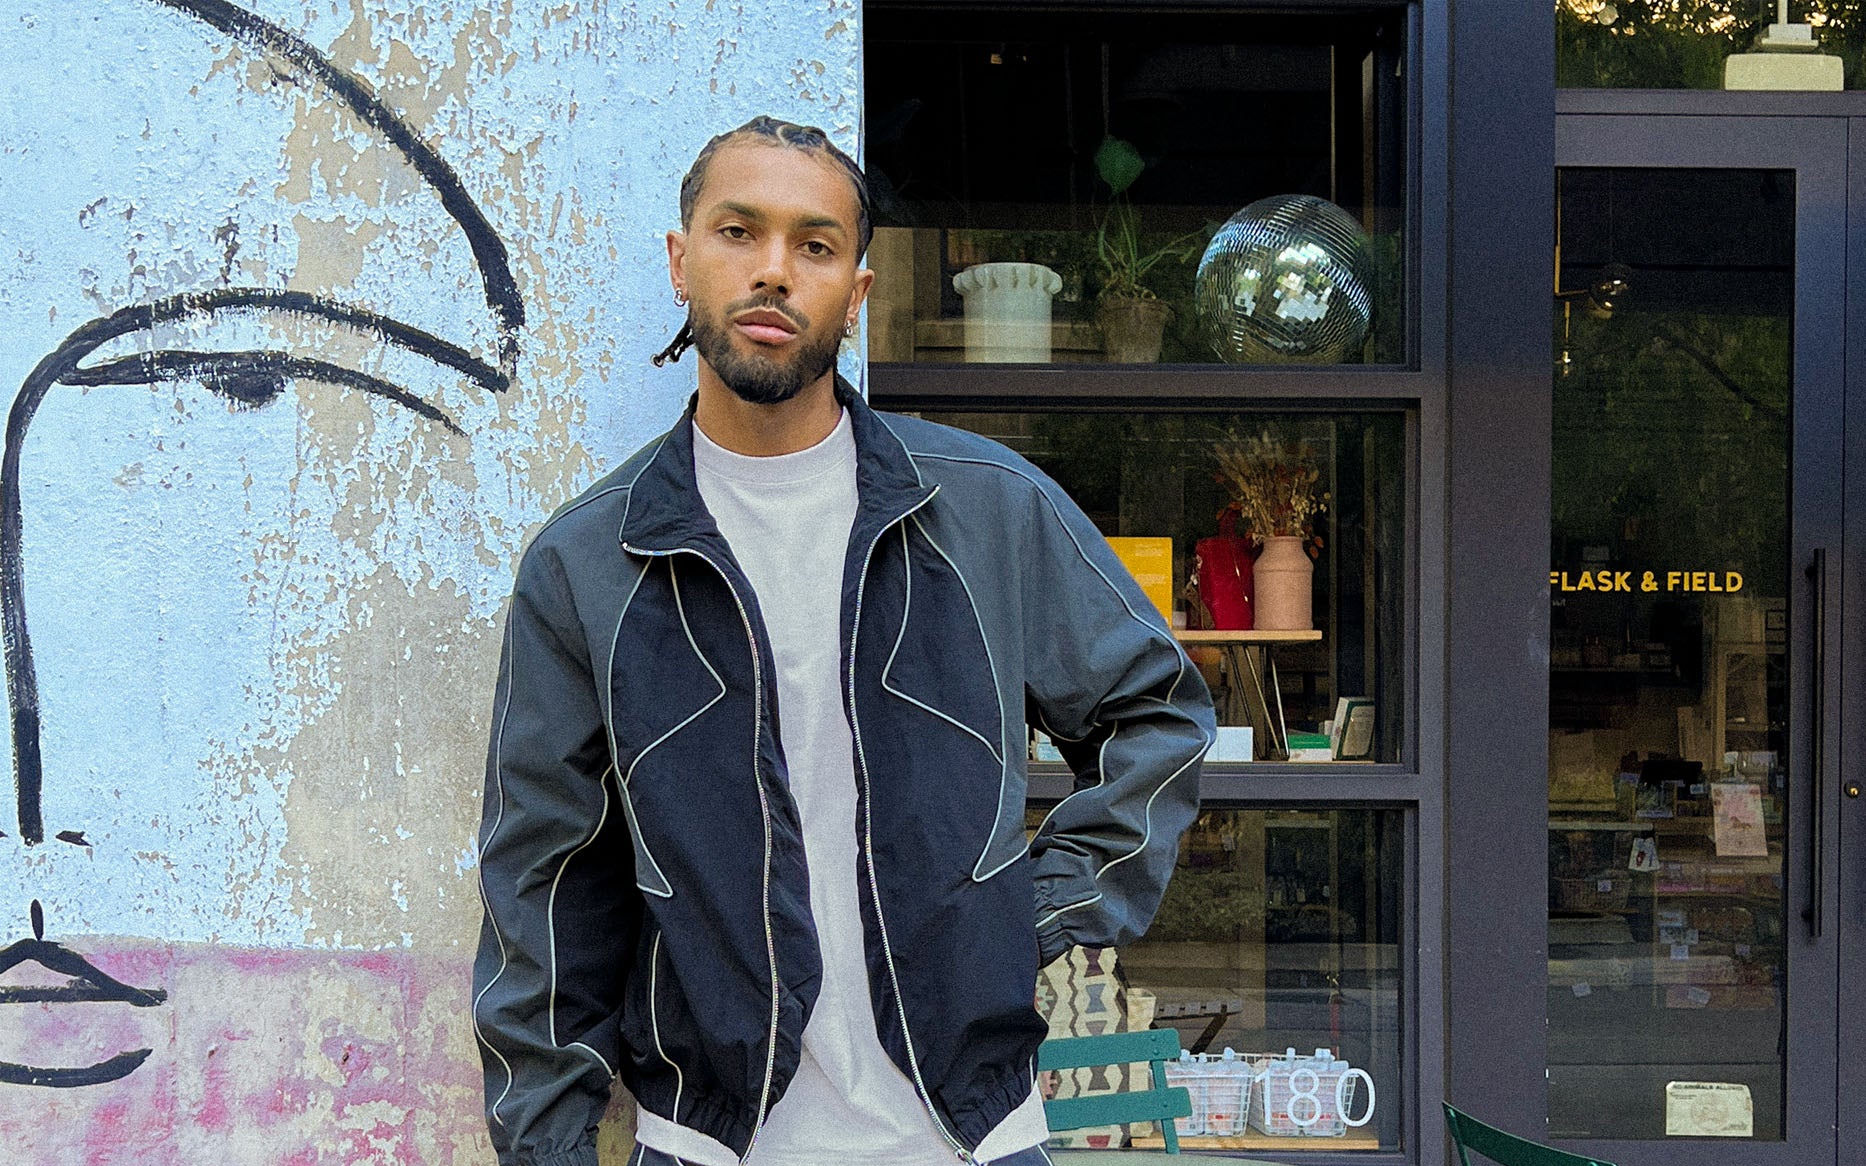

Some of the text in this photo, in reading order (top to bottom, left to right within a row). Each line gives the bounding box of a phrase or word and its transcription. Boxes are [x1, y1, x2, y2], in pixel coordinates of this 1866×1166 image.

[1640, 570, 1659, 592] &
[1667, 570, 1744, 592] FIELD
[1254, 1067, 1376, 1127] 180
